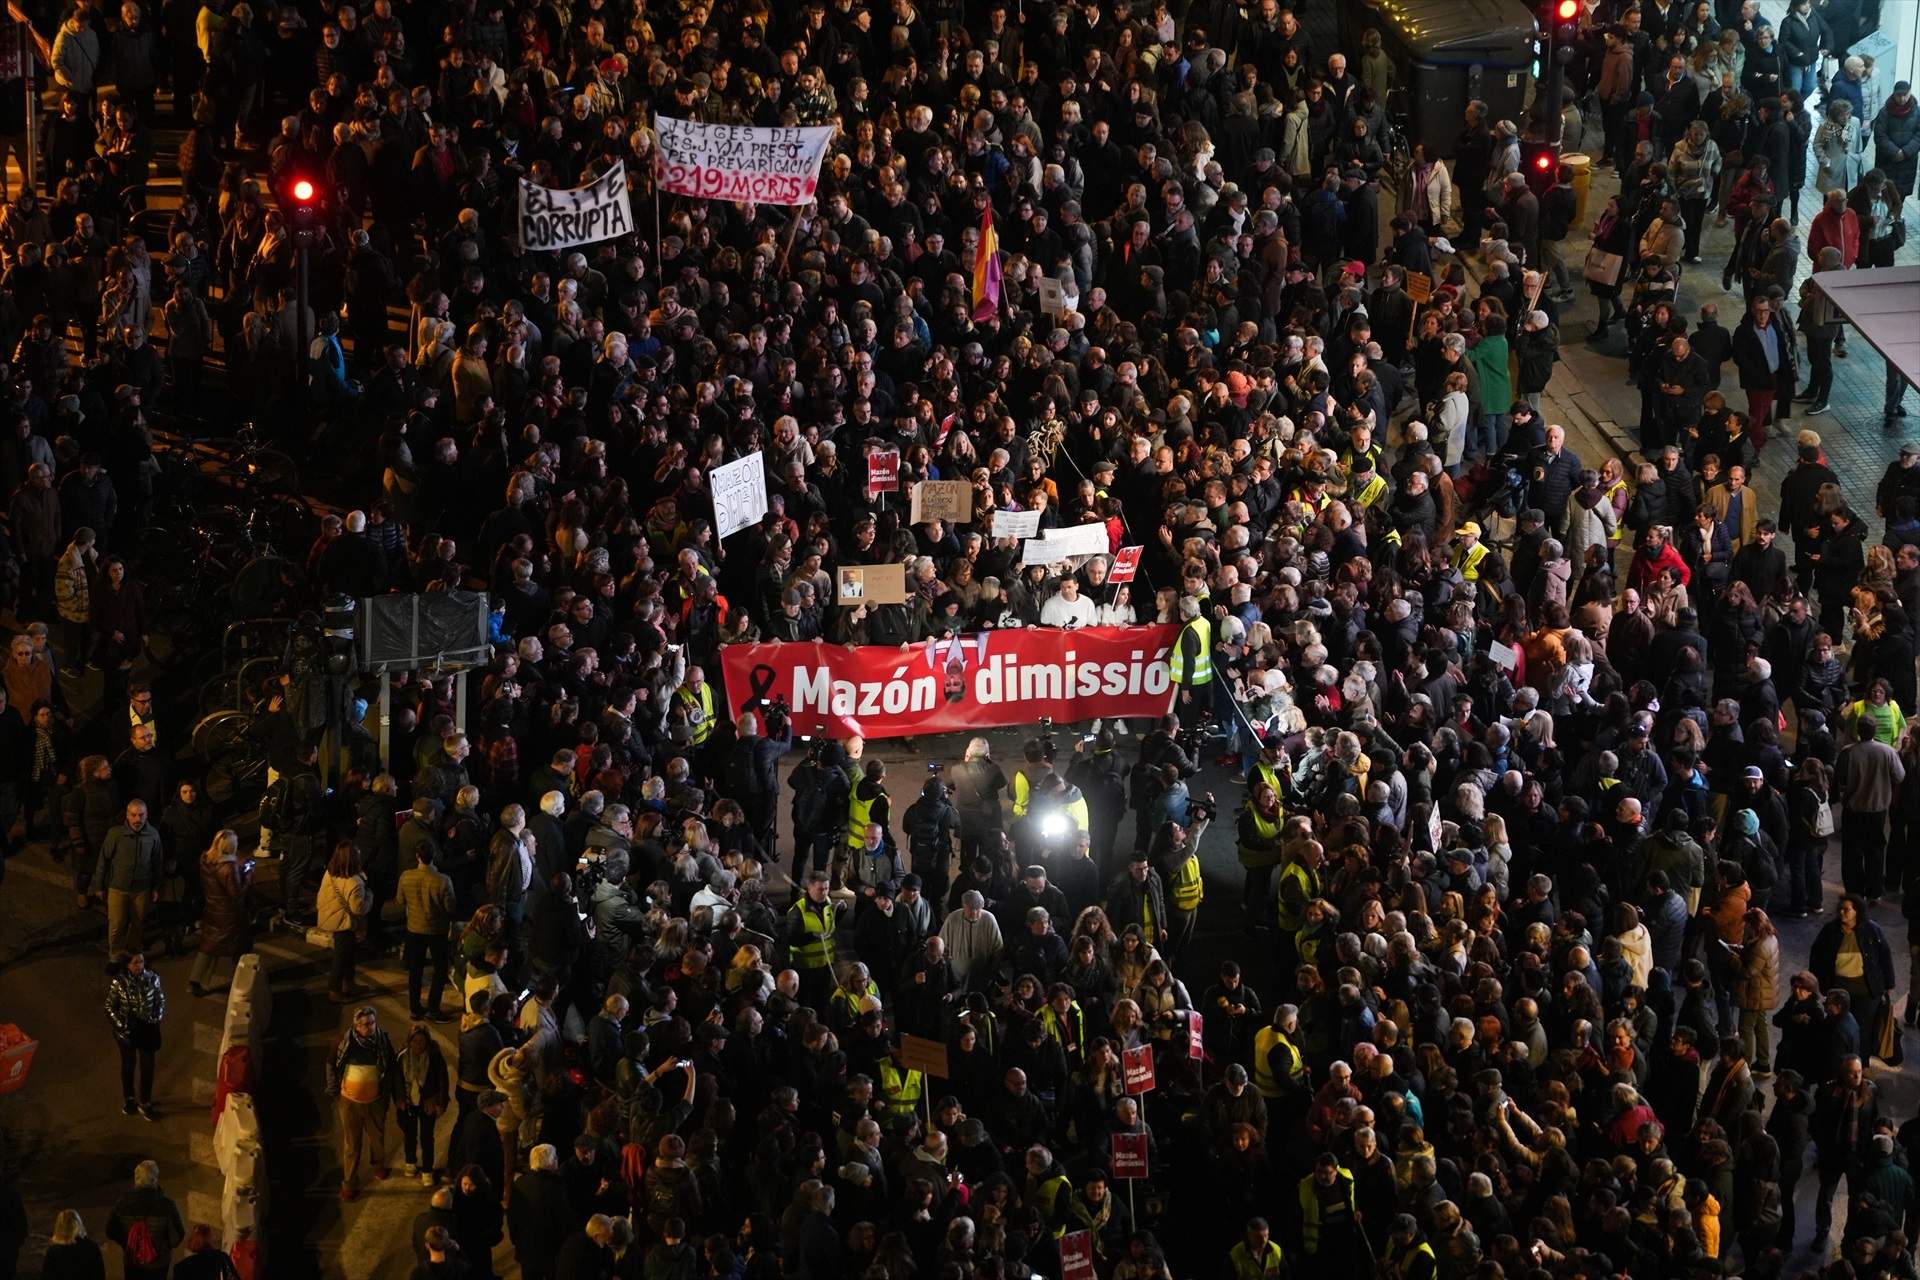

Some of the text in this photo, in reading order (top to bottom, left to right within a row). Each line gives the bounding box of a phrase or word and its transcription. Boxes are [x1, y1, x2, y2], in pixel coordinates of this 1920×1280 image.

[668, 120, 805, 143] JUTGES DEL
[667, 151, 813, 175] PER PREVARICACIÓ
[669, 165, 801, 199] 219 MORTS
[522, 199, 626, 247] CORRUPTA
[792, 648, 1170, 716] Mazón dimissió
